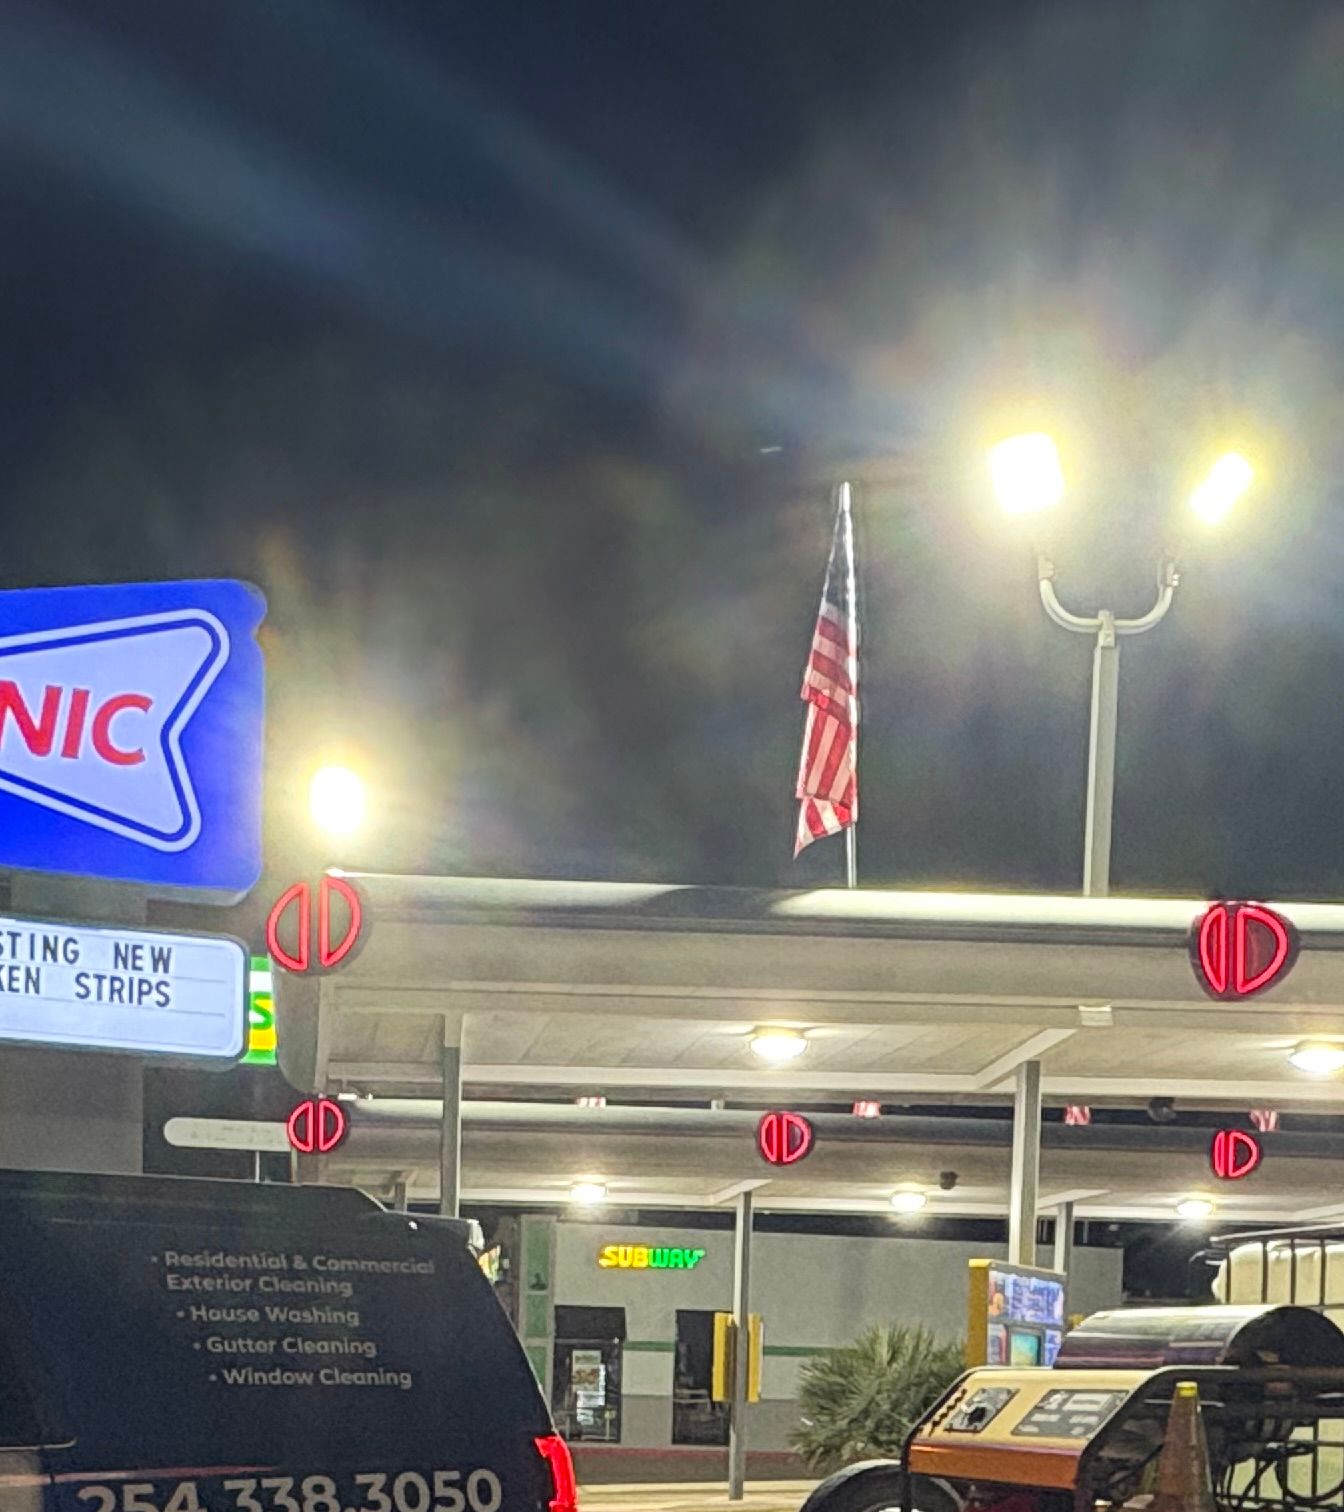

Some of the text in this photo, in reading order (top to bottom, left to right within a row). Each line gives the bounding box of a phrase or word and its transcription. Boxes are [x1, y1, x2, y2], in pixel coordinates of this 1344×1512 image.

[114, 942, 172, 974] NEW
[74, 972, 171, 1008] STRIPS
[164, 1251, 435, 1274] Residential & Commercial
[599, 1244, 706, 1269] SUBWAY
[166, 1274, 353, 1297] Exterior Cleaning
[190, 1306, 360, 1327] House Washing
[207, 1337, 377, 1357] Gutter Cleaning
[222, 1367, 412, 1389] Window Cleaning
